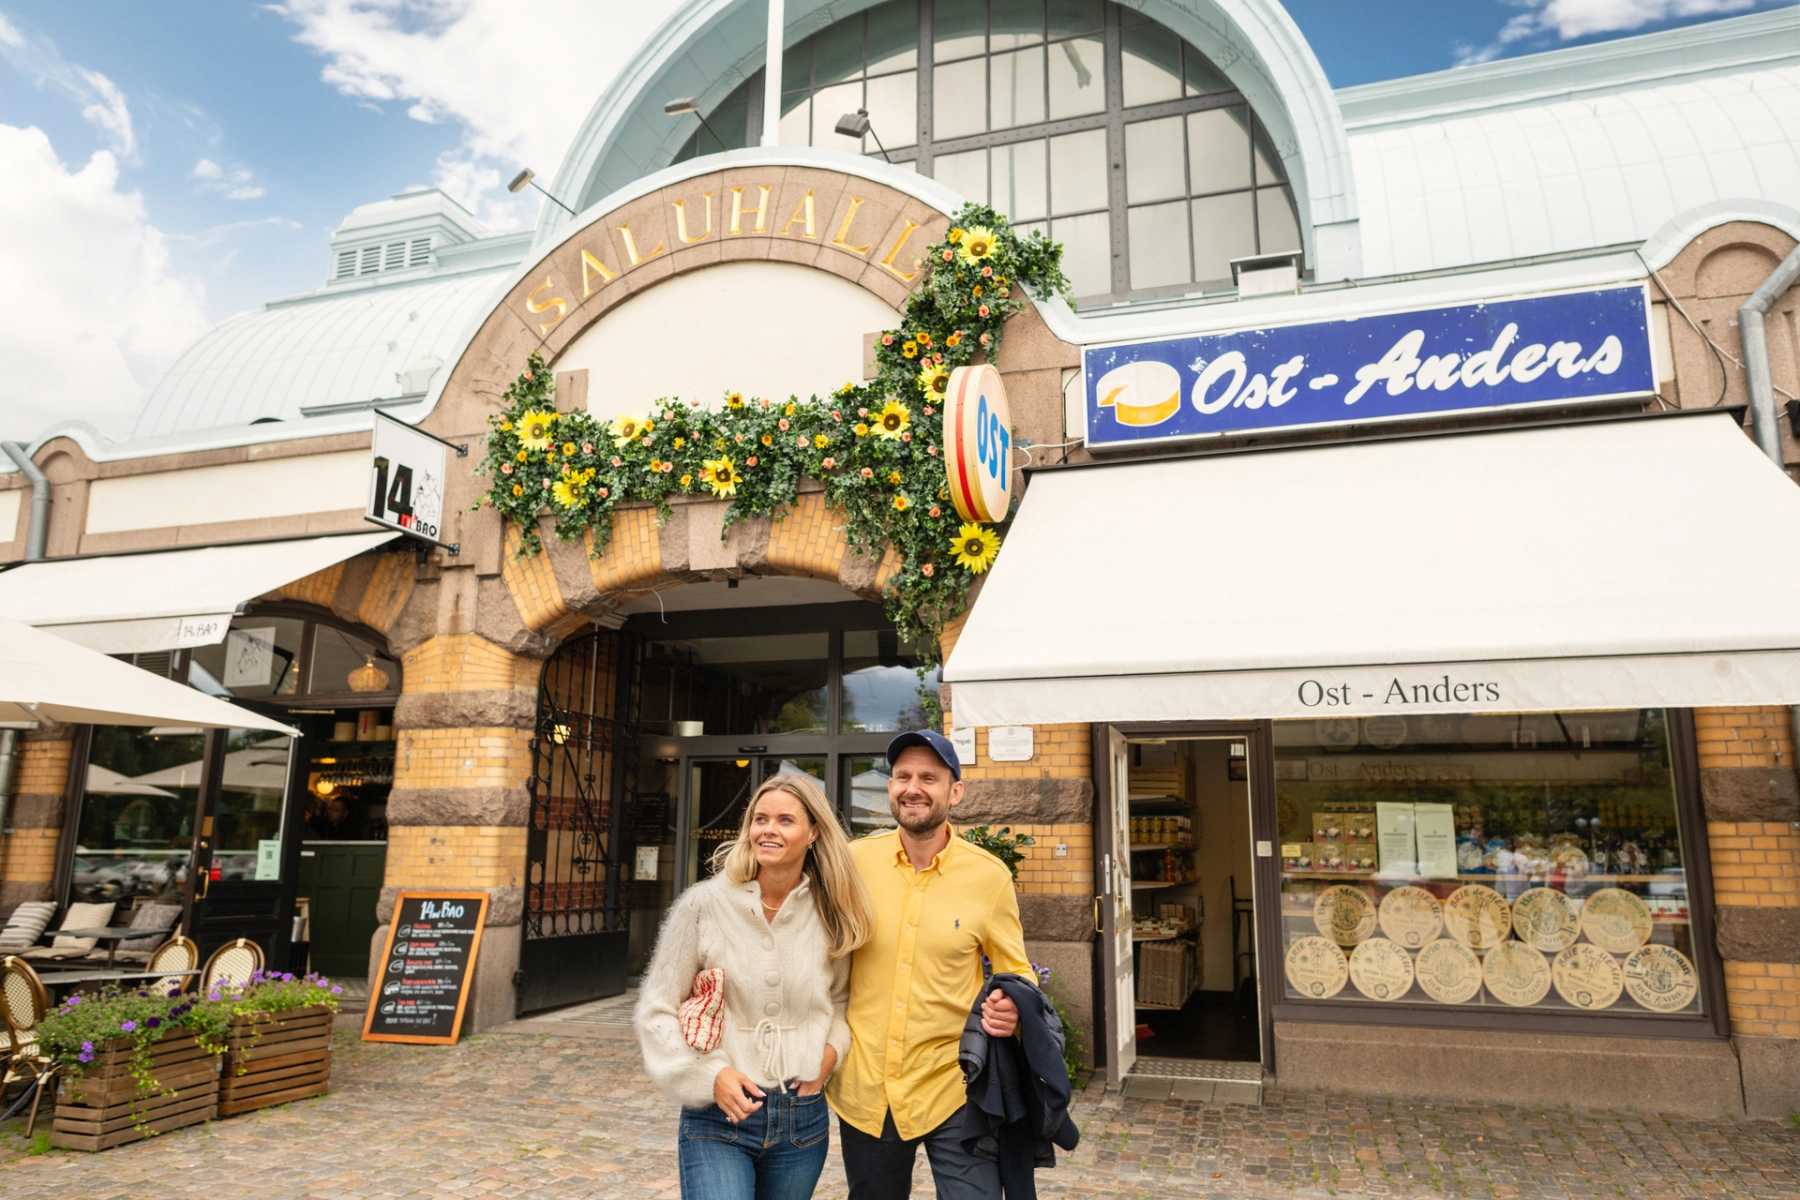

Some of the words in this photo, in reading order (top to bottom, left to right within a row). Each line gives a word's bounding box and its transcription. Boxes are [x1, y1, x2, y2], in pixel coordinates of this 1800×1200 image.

[526, 184, 920, 335] SALUHALL
[977, 394, 1009, 492] OST
[1383, 675, 1500, 705] Anders
[1450, 889, 1470, 909] BRIE
[1289, 942, 1306, 964] BRIE
[1558, 946, 1579, 968] BRIE
[1627, 947, 1652, 969] Brie
[1660, 946, 1692, 977] Meaux
